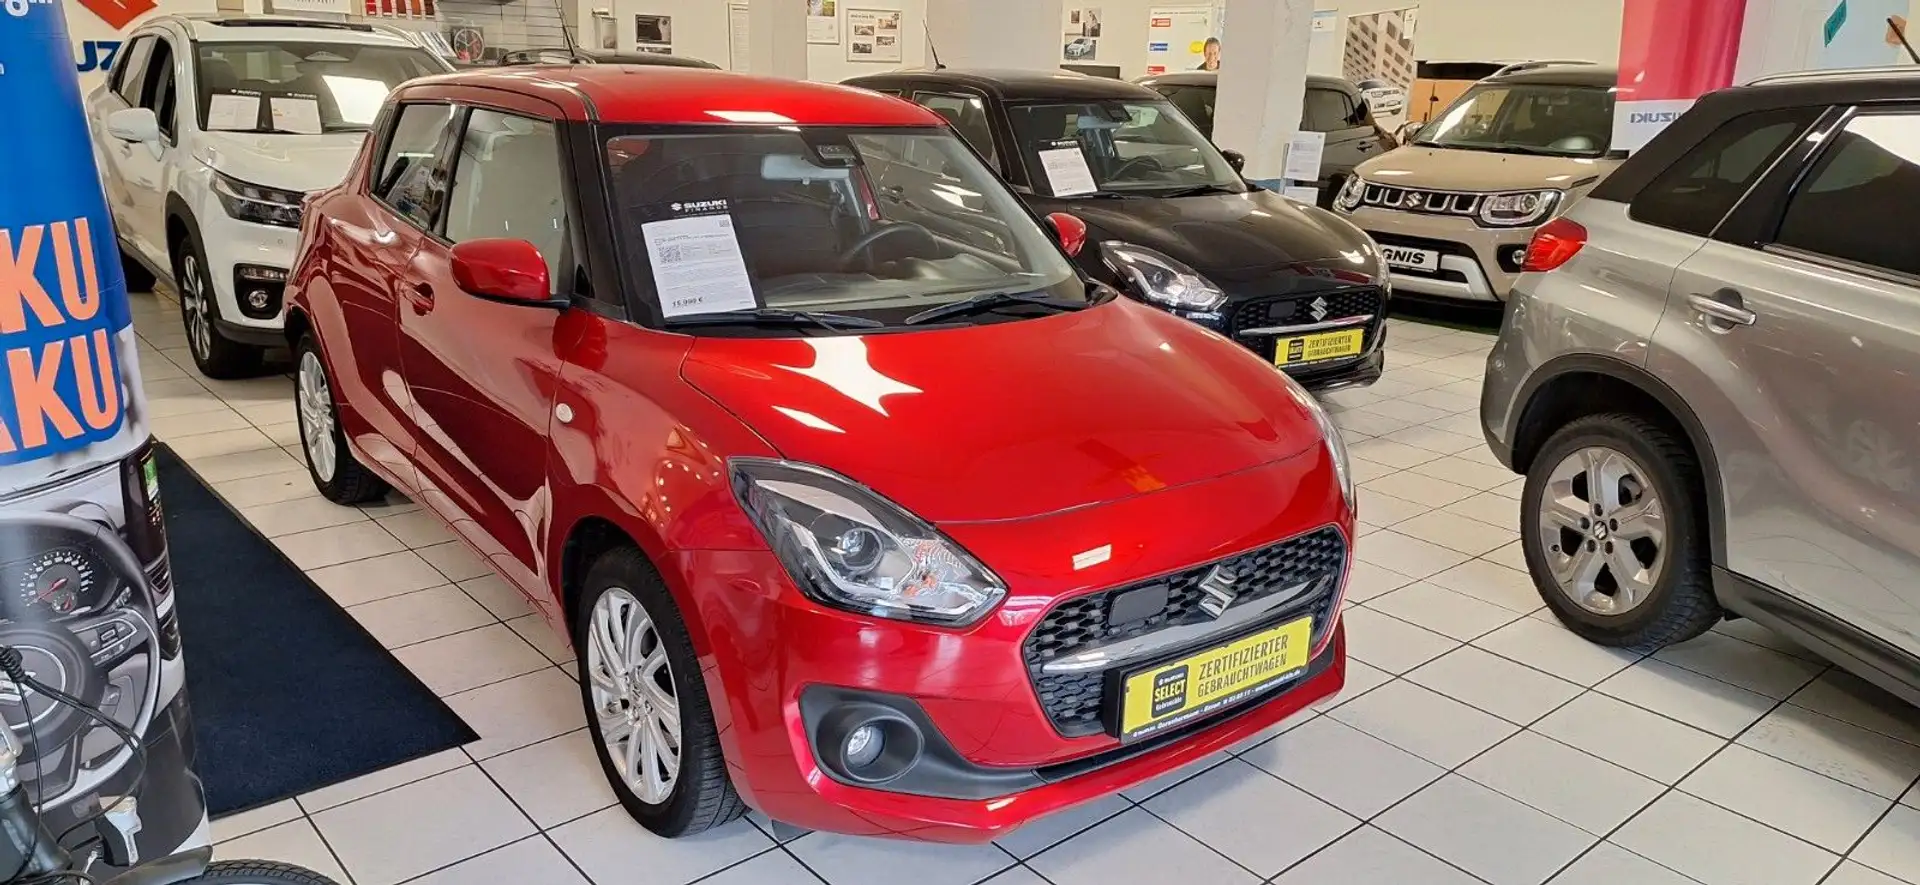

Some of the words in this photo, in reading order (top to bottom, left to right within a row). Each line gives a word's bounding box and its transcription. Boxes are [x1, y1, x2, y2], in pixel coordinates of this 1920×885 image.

[683, 199, 727, 209] SUZUKI
[0, 328, 119, 453] KU
[1197, 653, 1288, 697] GEBRAUCHTWAGEN
[1198, 634, 1289, 681] ZERTIFIZIERTER
[1154, 679, 1186, 703] SELECT
